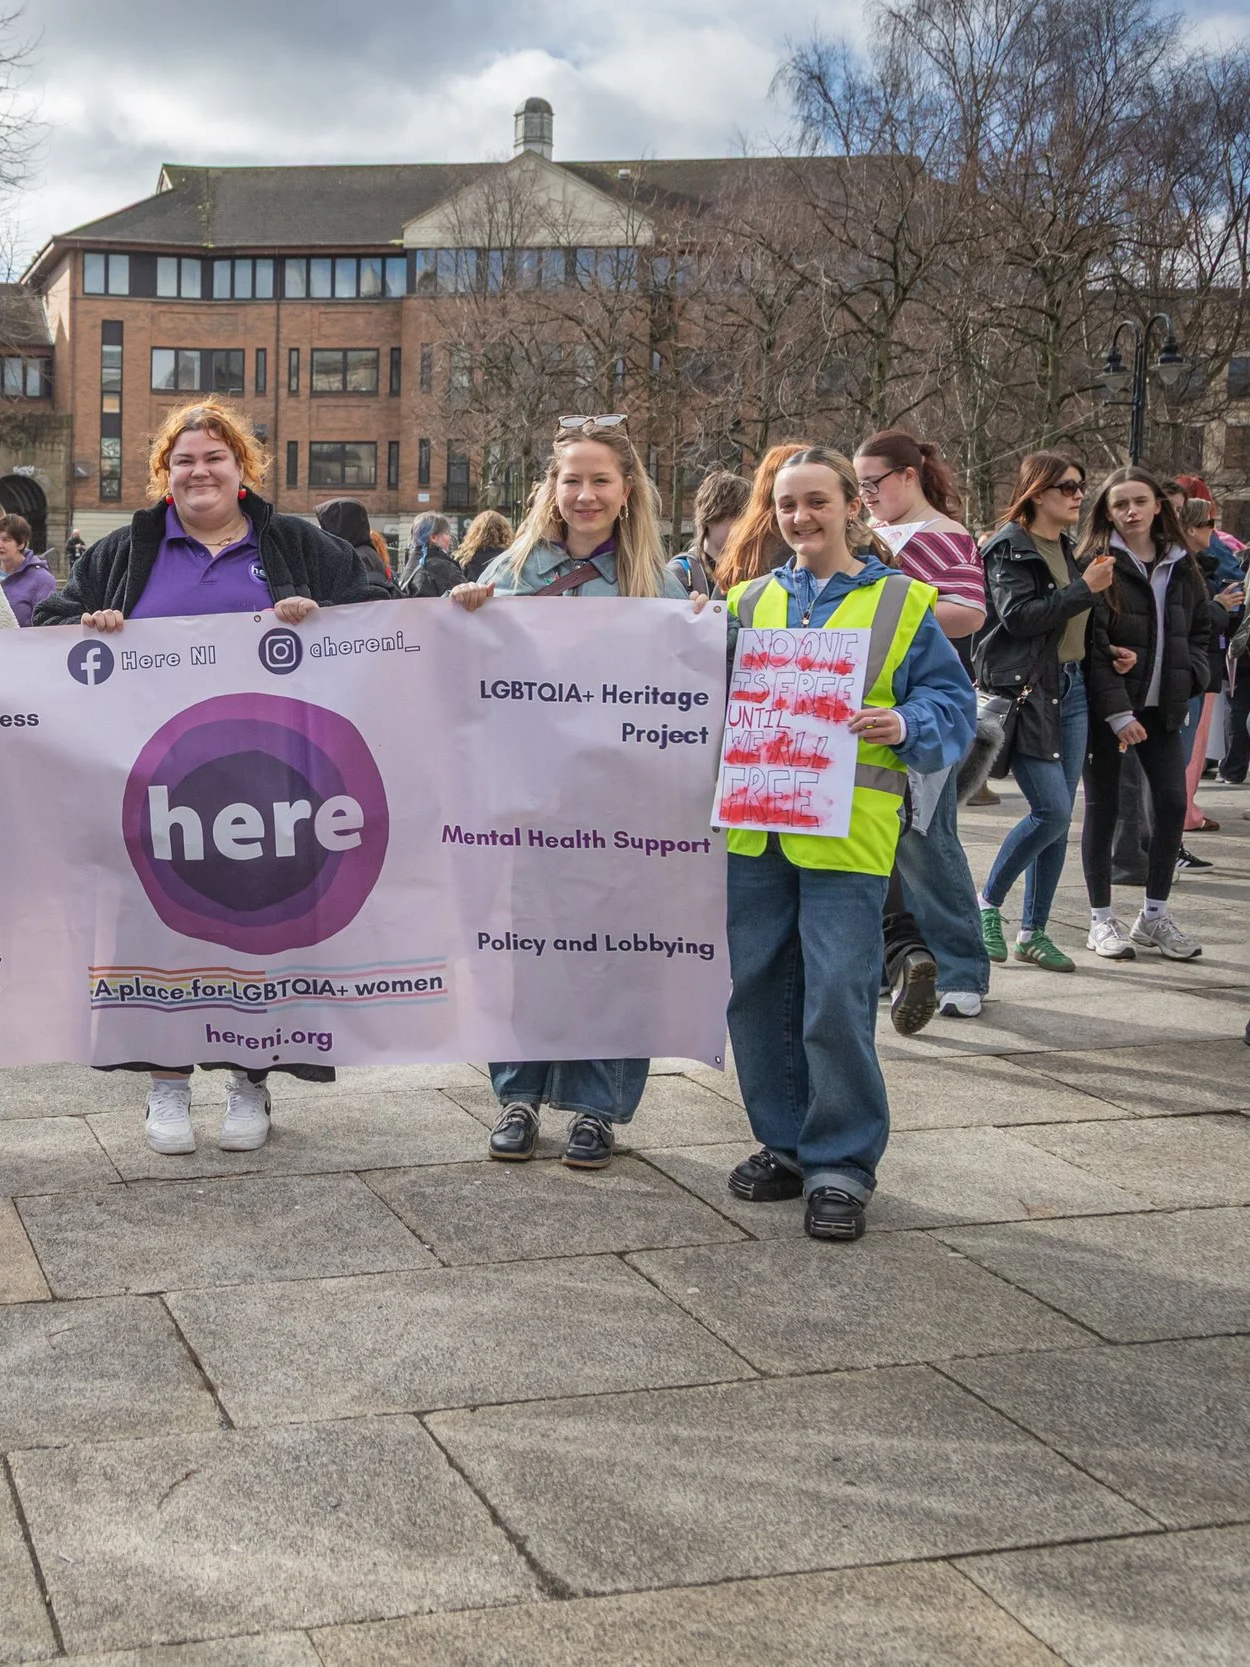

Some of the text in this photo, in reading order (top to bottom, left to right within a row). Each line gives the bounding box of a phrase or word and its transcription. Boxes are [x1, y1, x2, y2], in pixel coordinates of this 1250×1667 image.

[121, 650, 180, 670] Here
[190, 645, 216, 665] NI
[480, 681, 709, 711] LGBTQIA+ Heritage
[730, 671, 855, 723] IS FREE
[727, 704, 791, 730] UNTIL
[622, 723, 709, 749] Project
[724, 728, 830, 769] WE ALL
[719, 766, 820, 828] FREE
[147, 784, 365, 861] here
[441, 825, 711, 856] Mental Health Support
[478, 932, 715, 960] Policy and Lobbying
[94, 975, 443, 1002] A place for LGBTQIA+ women
[206, 1024, 333, 1050] hereni.org
